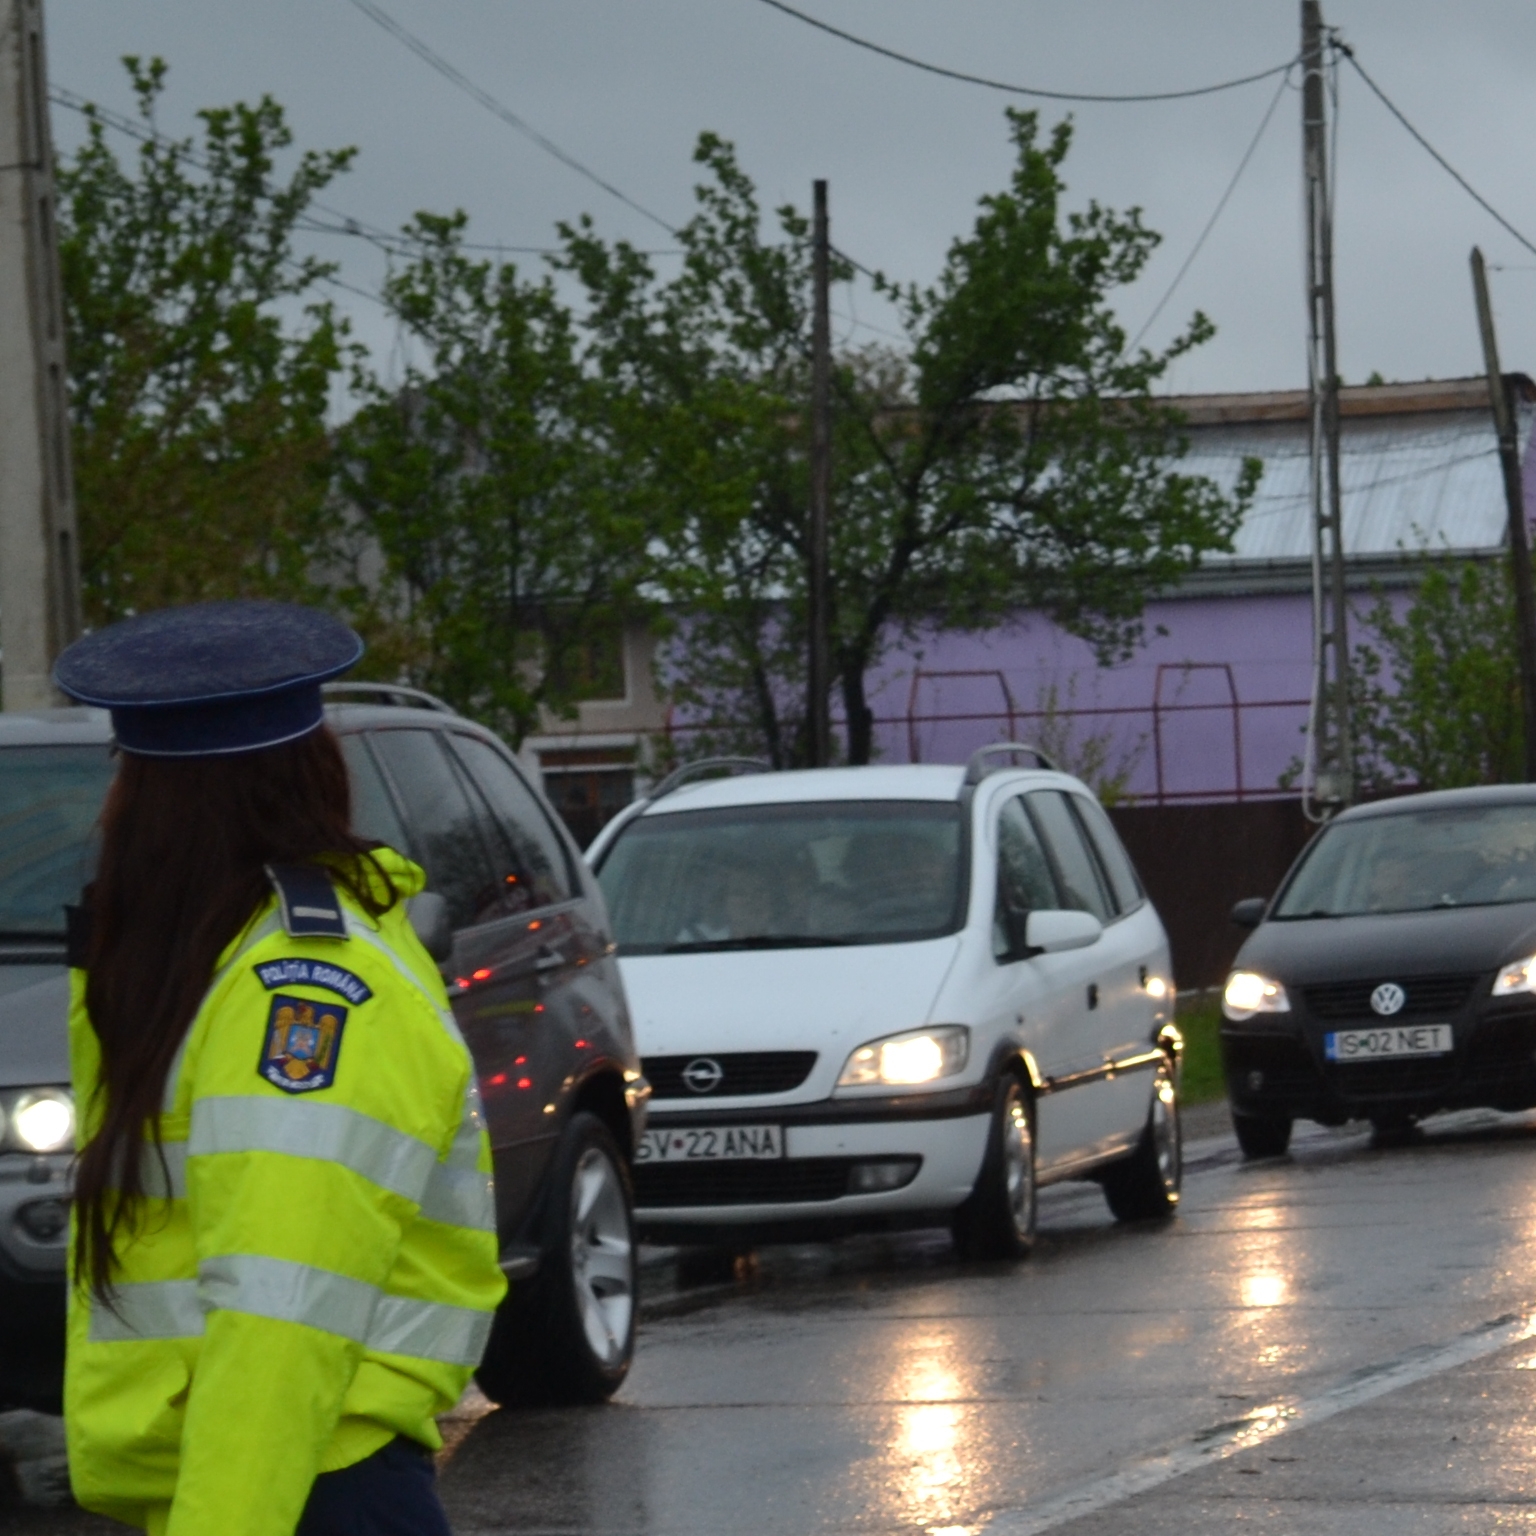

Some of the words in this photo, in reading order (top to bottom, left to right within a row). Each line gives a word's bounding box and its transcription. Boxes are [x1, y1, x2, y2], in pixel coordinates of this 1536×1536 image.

[1367, 1032, 1392, 1052] 02
[1398, 1028, 1441, 1050] NET
[634, 1132, 671, 1159] SV
[686, 1131, 717, 1157] 22
[725, 1127, 775, 1155] ANA
